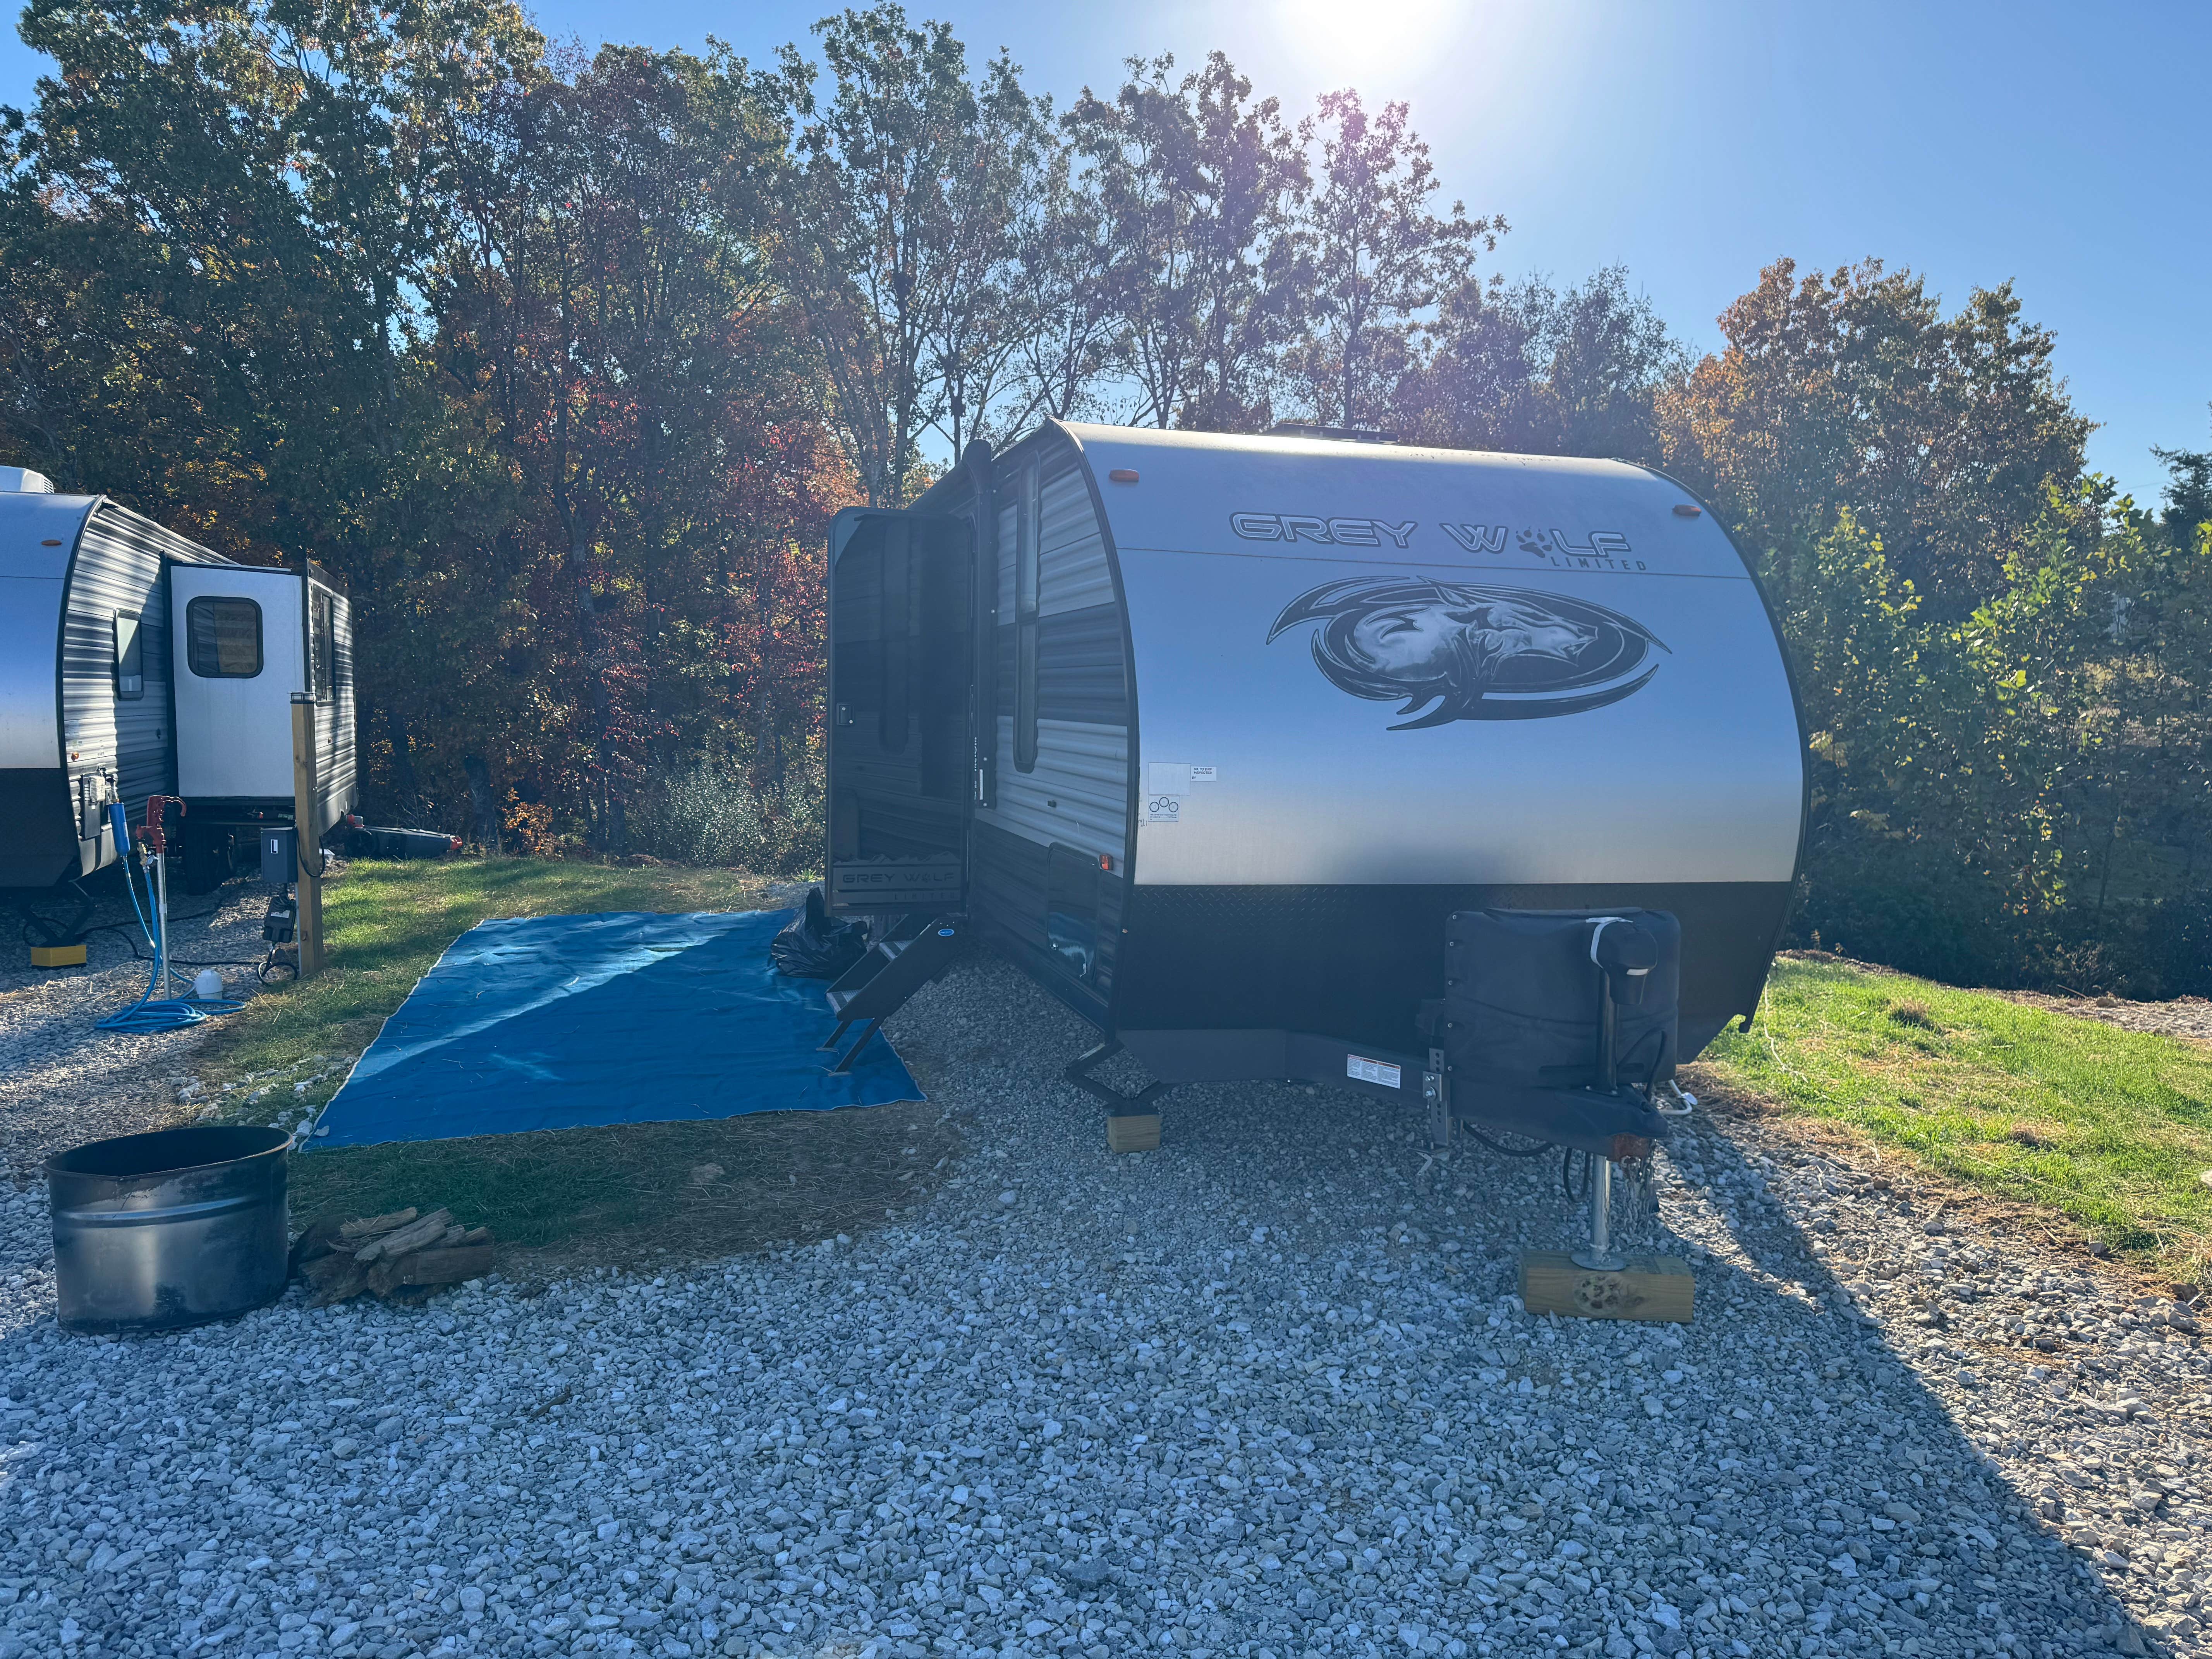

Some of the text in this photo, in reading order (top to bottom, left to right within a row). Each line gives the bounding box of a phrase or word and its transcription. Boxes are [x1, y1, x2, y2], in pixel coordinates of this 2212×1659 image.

[1229, 512, 1419, 548] GREY
[1550, 556, 1647, 571] LIMITED
[272, 840, 277, 853] L
[842, 873, 895, 883] GREY
